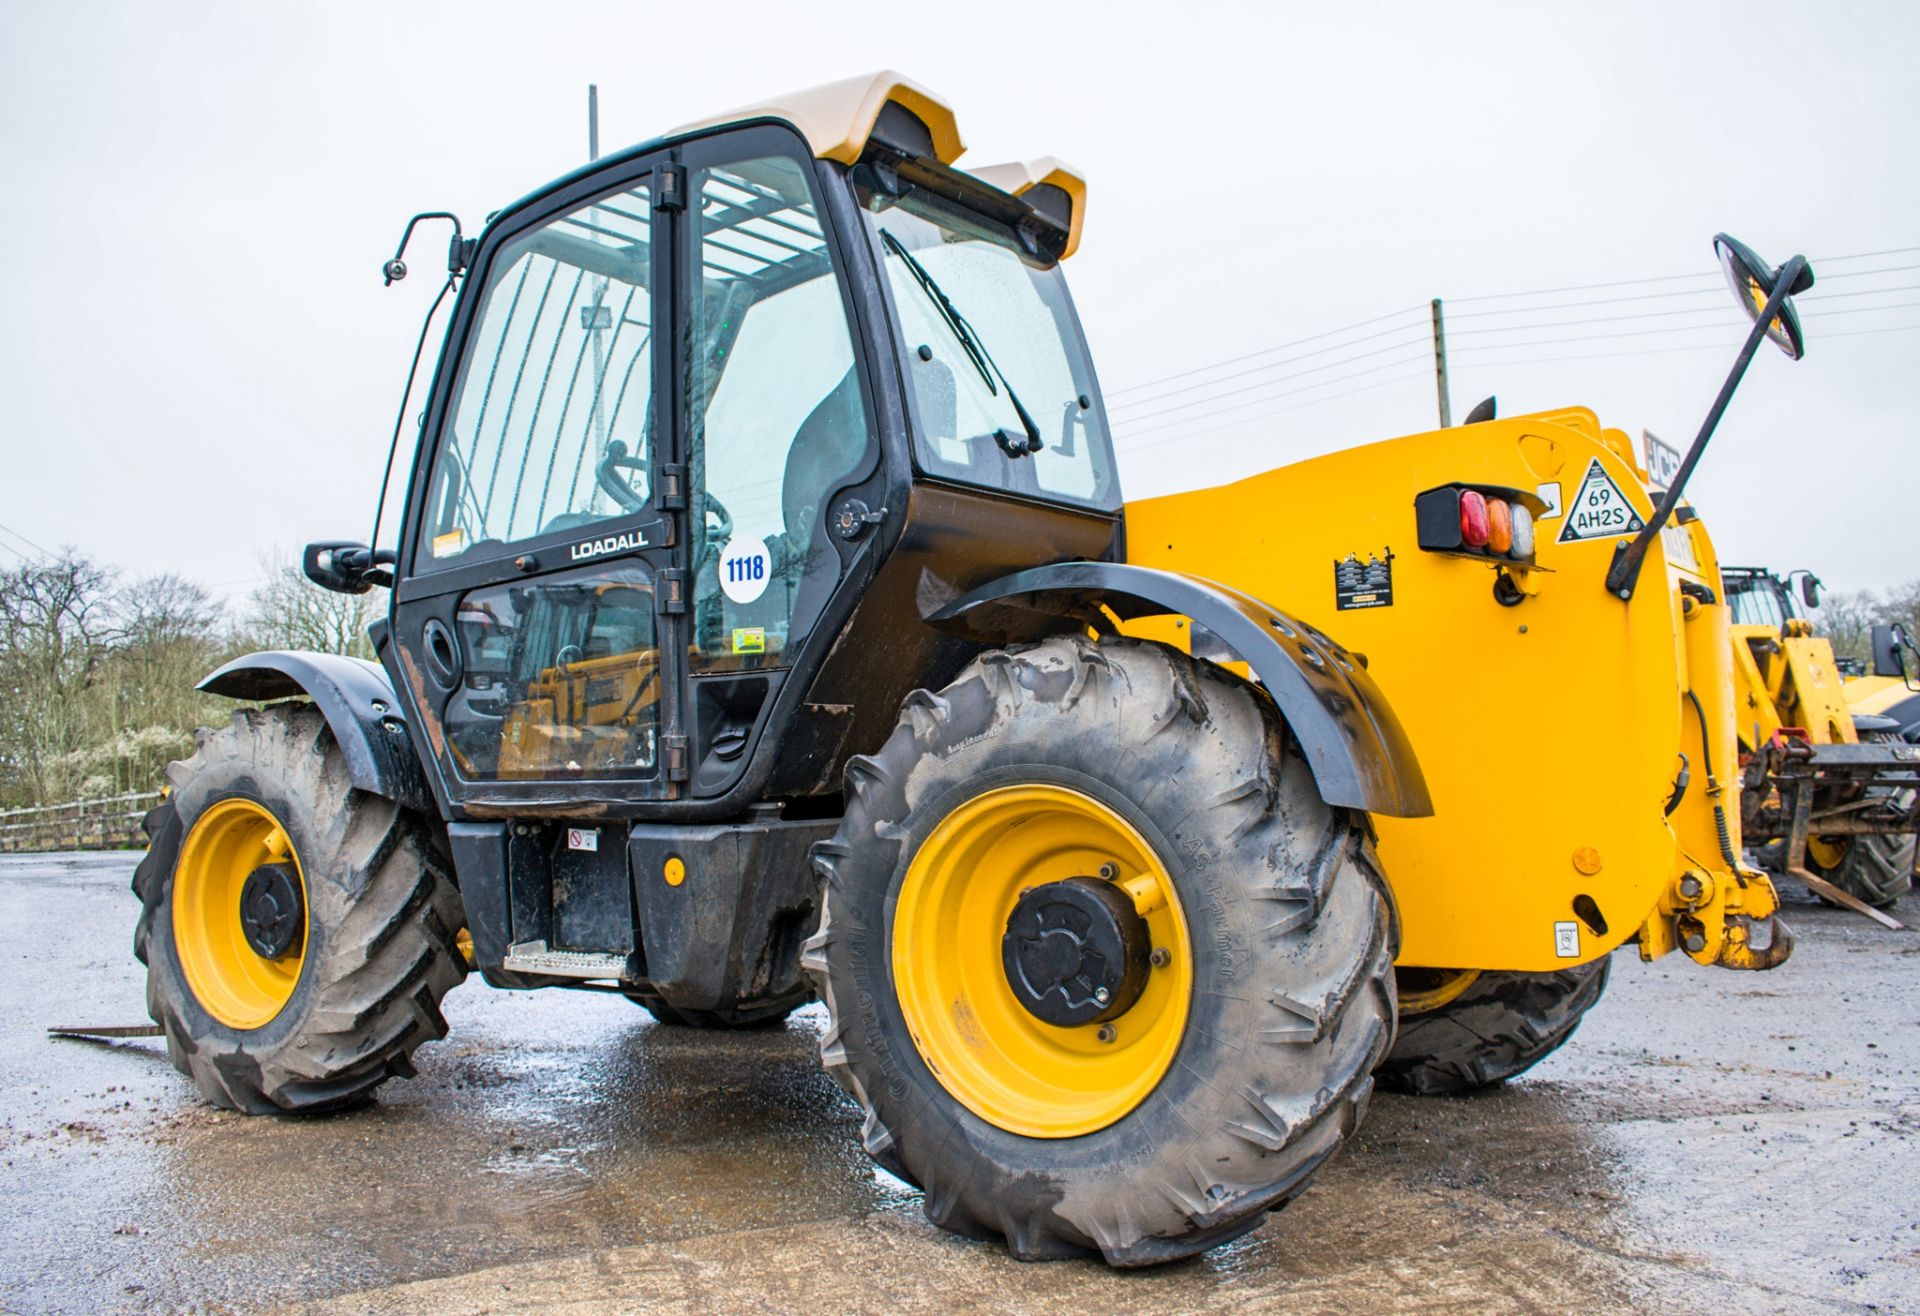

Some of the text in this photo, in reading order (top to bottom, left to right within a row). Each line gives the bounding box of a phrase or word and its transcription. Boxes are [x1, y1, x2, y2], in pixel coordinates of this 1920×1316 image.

[1588, 488, 1611, 507] 69
[1578, 507, 1625, 529] AH2S
[570, 531, 649, 561] LOADALL
[727, 555, 765, 582] 1118
